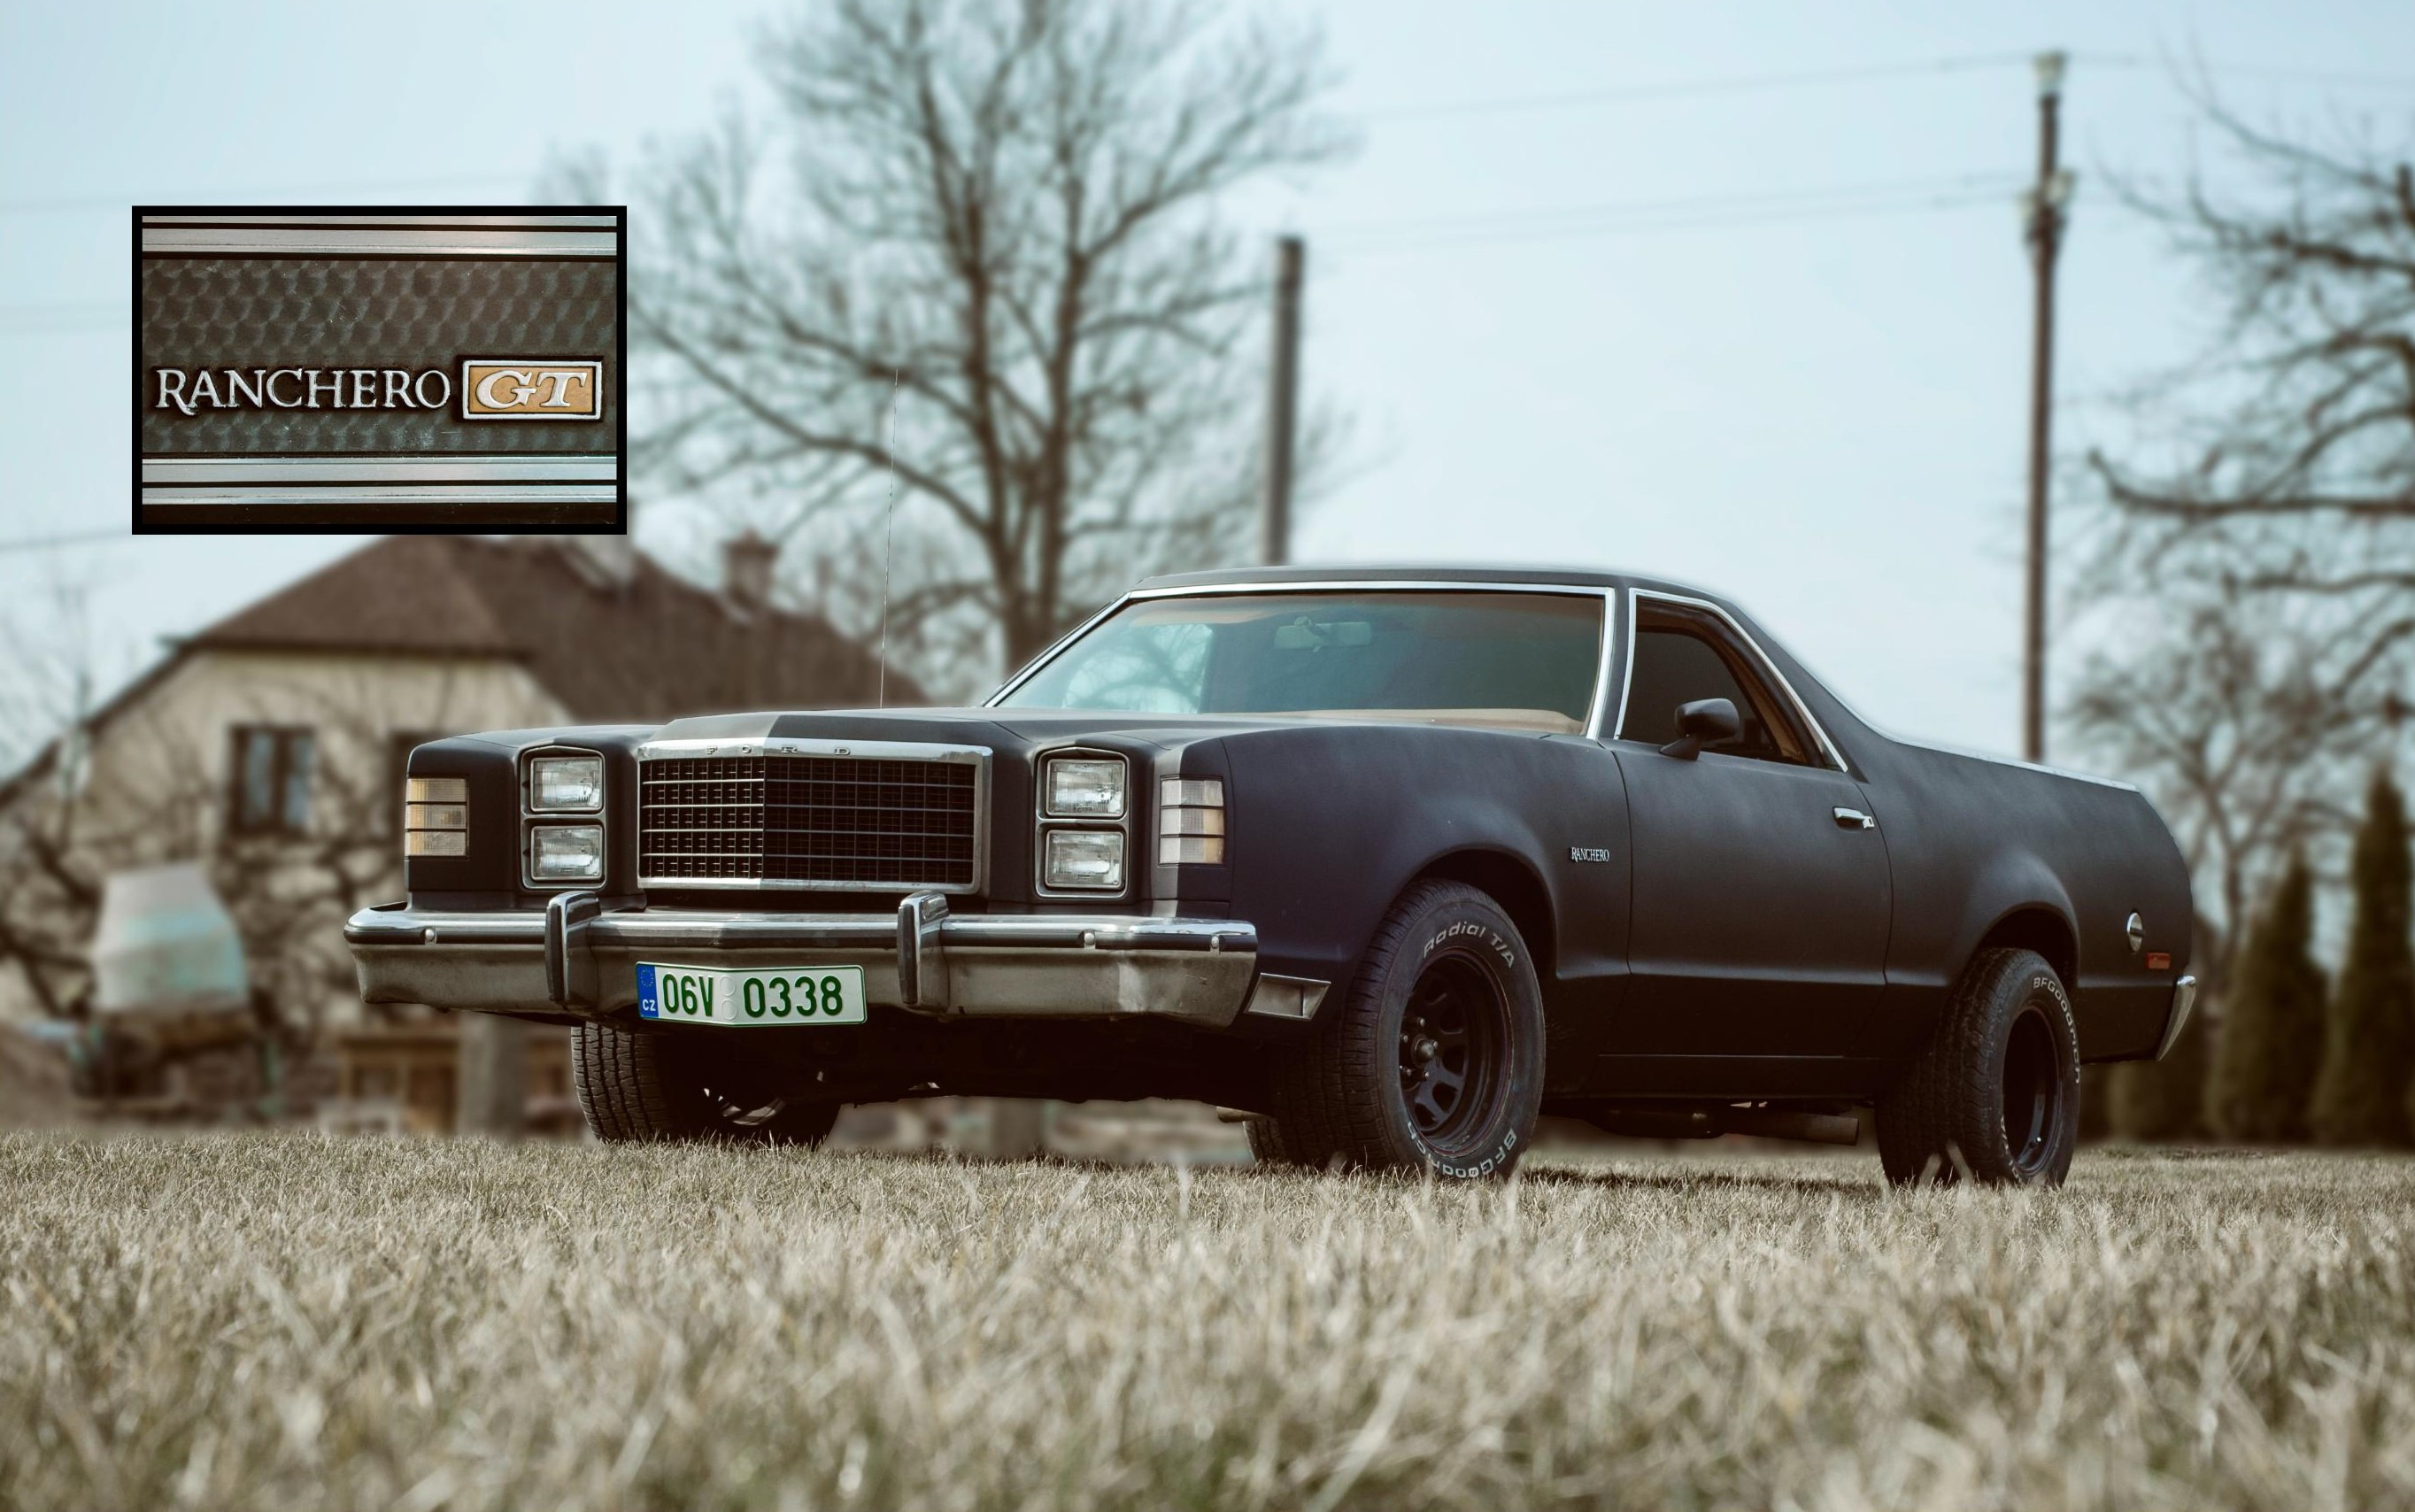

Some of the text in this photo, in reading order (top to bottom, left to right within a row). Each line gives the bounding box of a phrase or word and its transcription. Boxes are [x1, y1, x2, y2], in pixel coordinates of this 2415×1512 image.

[155, 366, 588, 416] RANCHERO GT
[1571, 846, 1610, 863] RANCHERO
[1423, 921, 1515, 969] Radial T/A
[642, 999, 657, 1012] CZ
[662, 973, 844, 1018] 06V 0338
